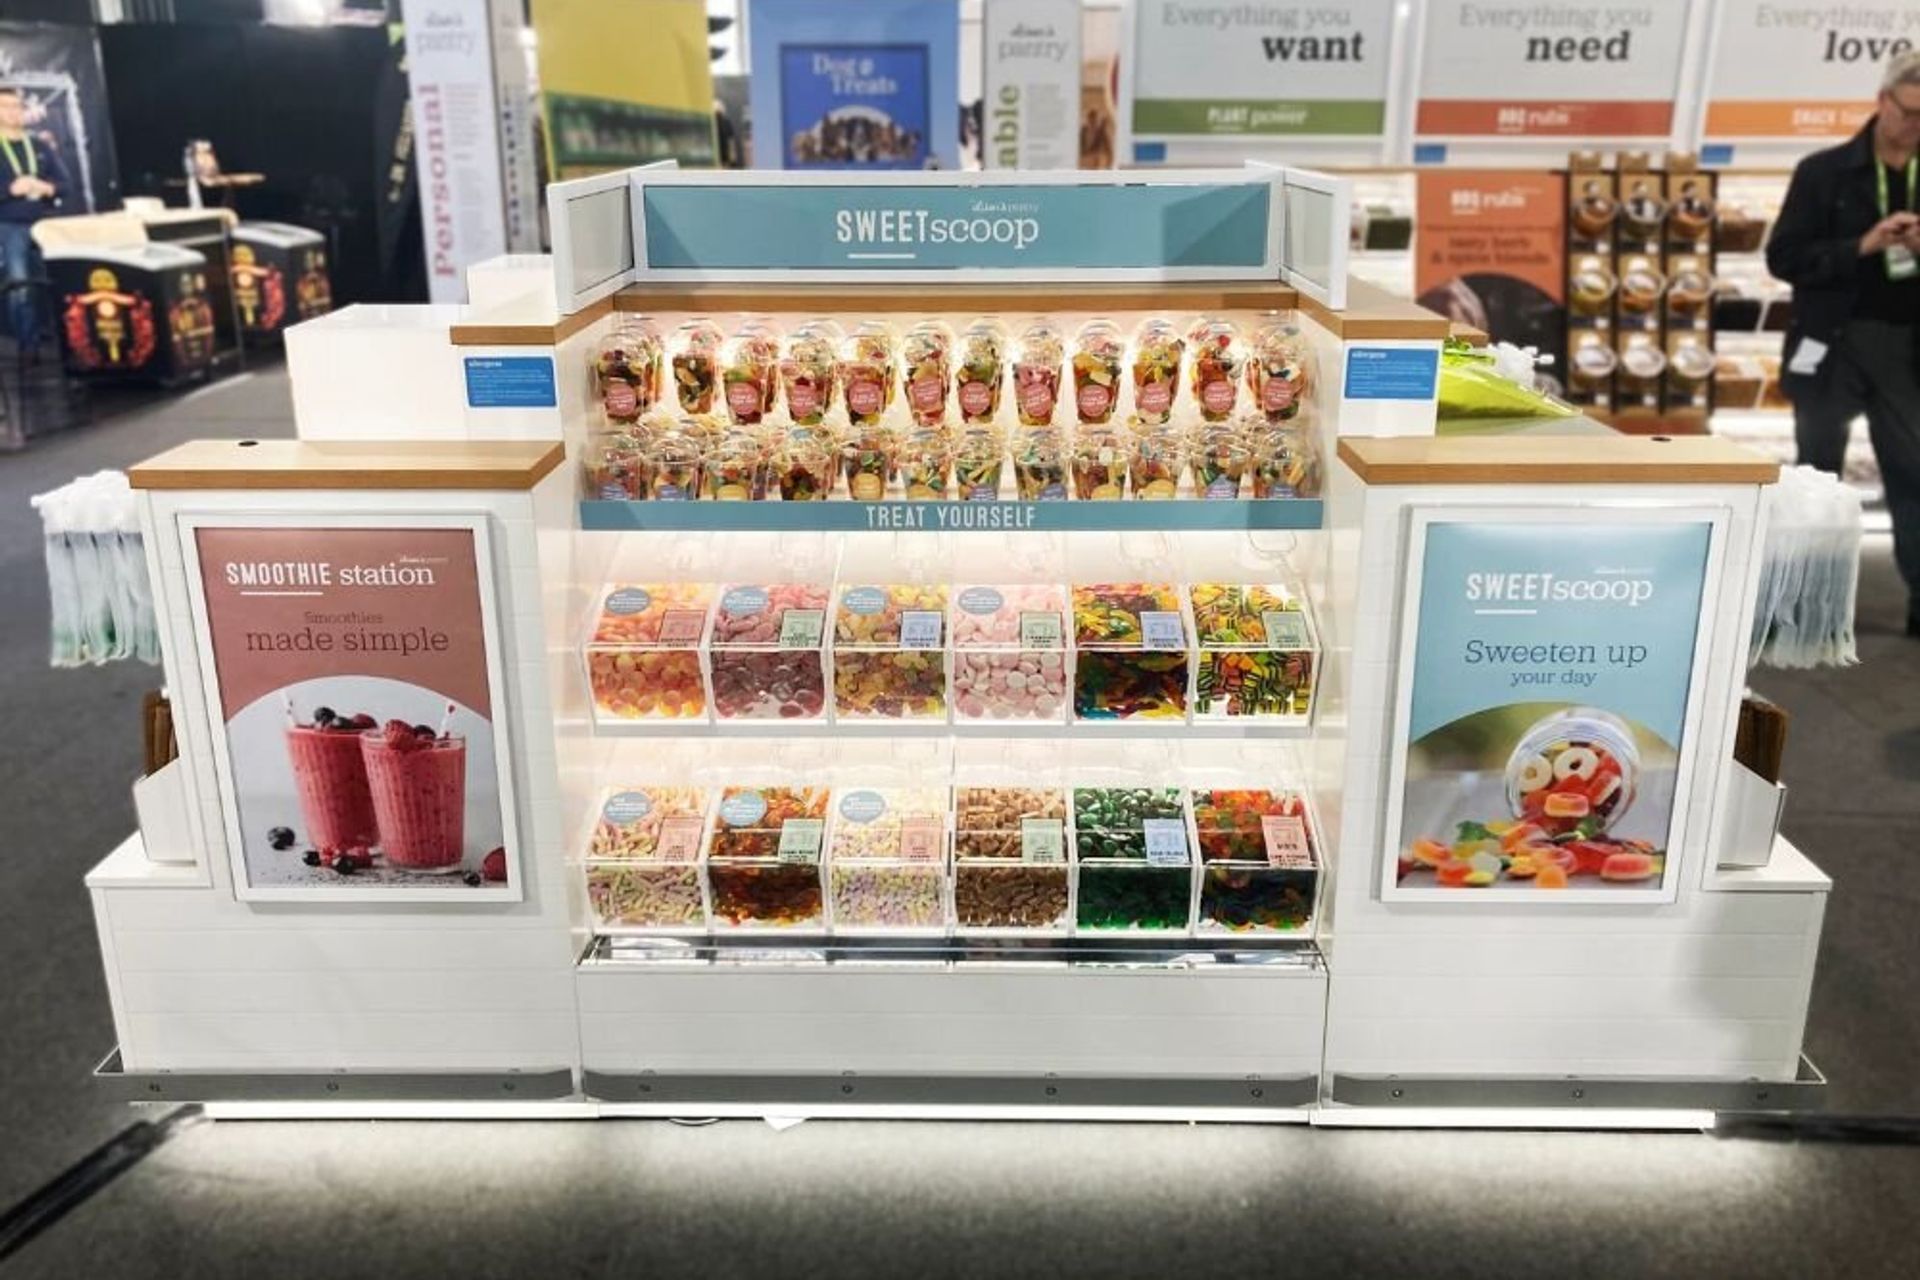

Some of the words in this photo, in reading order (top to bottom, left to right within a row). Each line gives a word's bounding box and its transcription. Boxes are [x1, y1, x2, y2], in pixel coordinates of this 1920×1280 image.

[1162, 3, 1299, 30] Everything
[1304, 8, 1352, 30] you
[1459, 3, 1599, 31] Everything
[1603, 8, 1654, 30] you
[1755, 4, 1895, 31] Everything
[1261, 31, 1364, 62] want
[1525, 29, 1631, 62] need
[1823, 29, 1913, 62] love
[831, 76, 898, 95] Treats
[417, 83, 455, 276] Personal
[866, 505, 925, 528] TREAT
[937, 505, 1036, 528] YOURSELF
[225, 561, 332, 586] SMOOTHIE
[339, 561, 436, 587] station
[304, 610, 384, 625] Smoothies
[246, 627, 335, 652] made
[342, 626, 450, 656] simple
[1464, 639, 1597, 664] Sweeten
[1607, 645, 1648, 668] up
[1509, 670, 1556, 687] your
[1560, 668, 1598, 687] day
